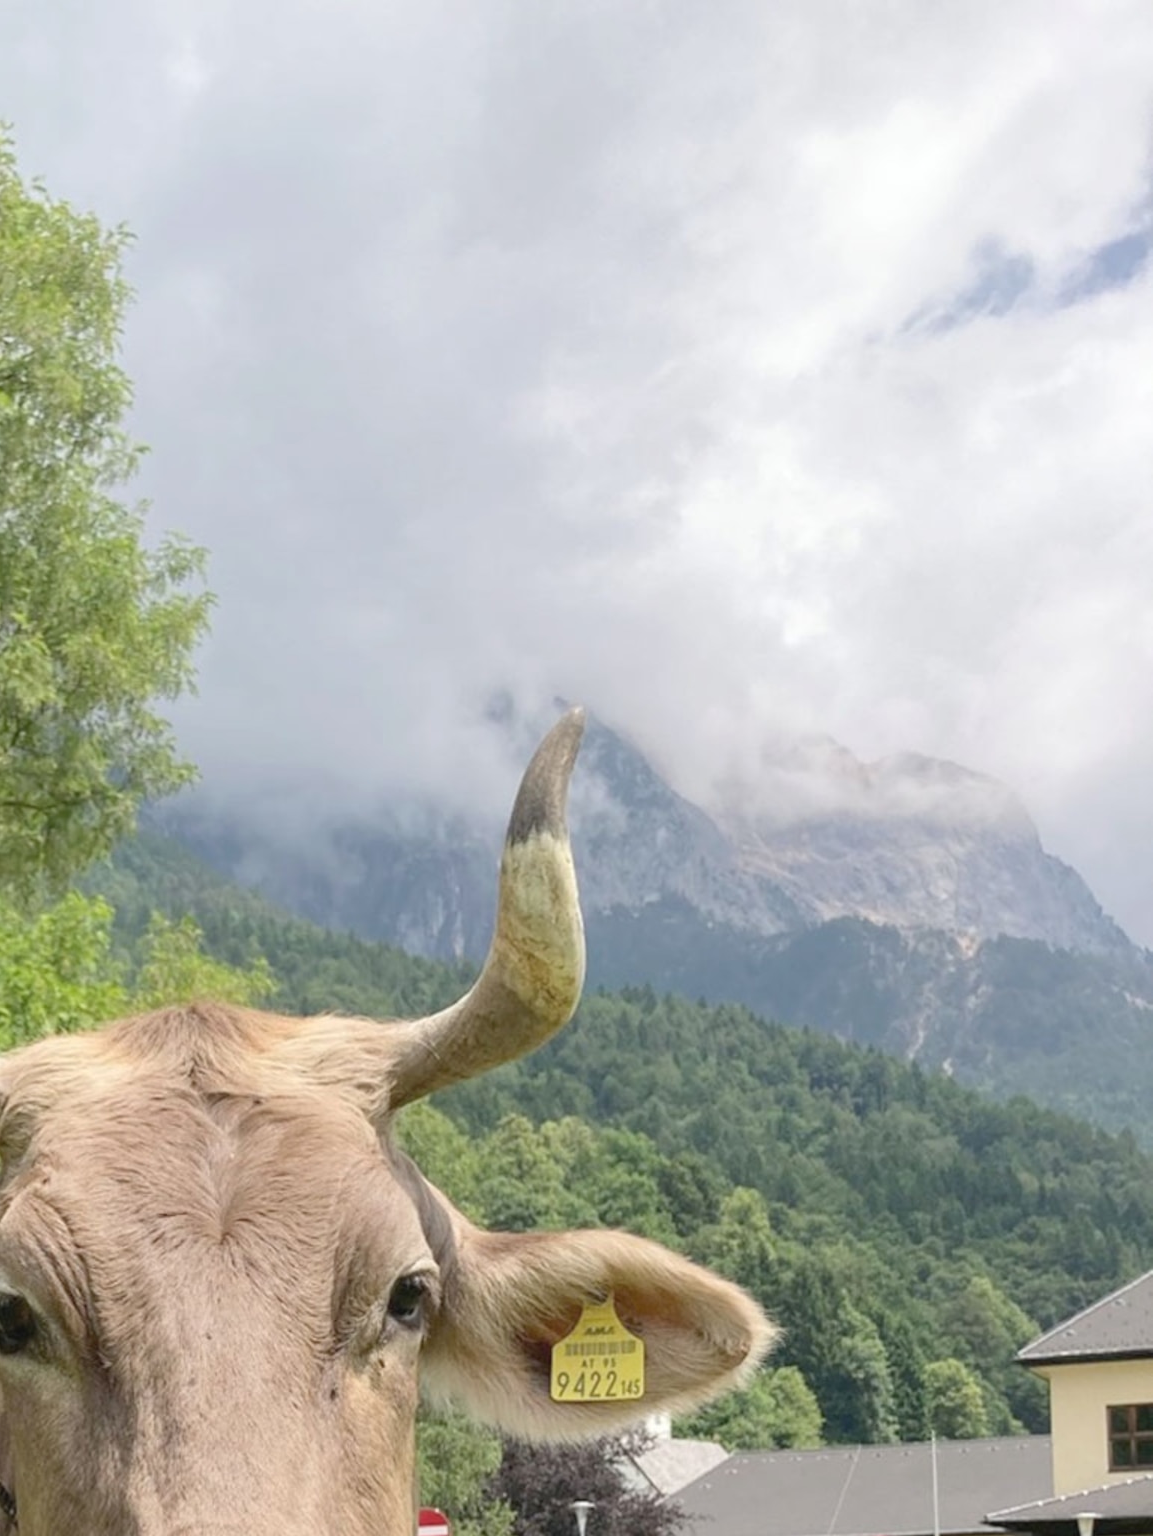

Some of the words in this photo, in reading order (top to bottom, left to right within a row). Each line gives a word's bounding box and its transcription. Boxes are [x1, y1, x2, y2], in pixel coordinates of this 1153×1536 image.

[581, 1358, 595, 1369] AT
[557, 1371, 617, 1397] 9422
[621, 1379, 640, 1395] 145
